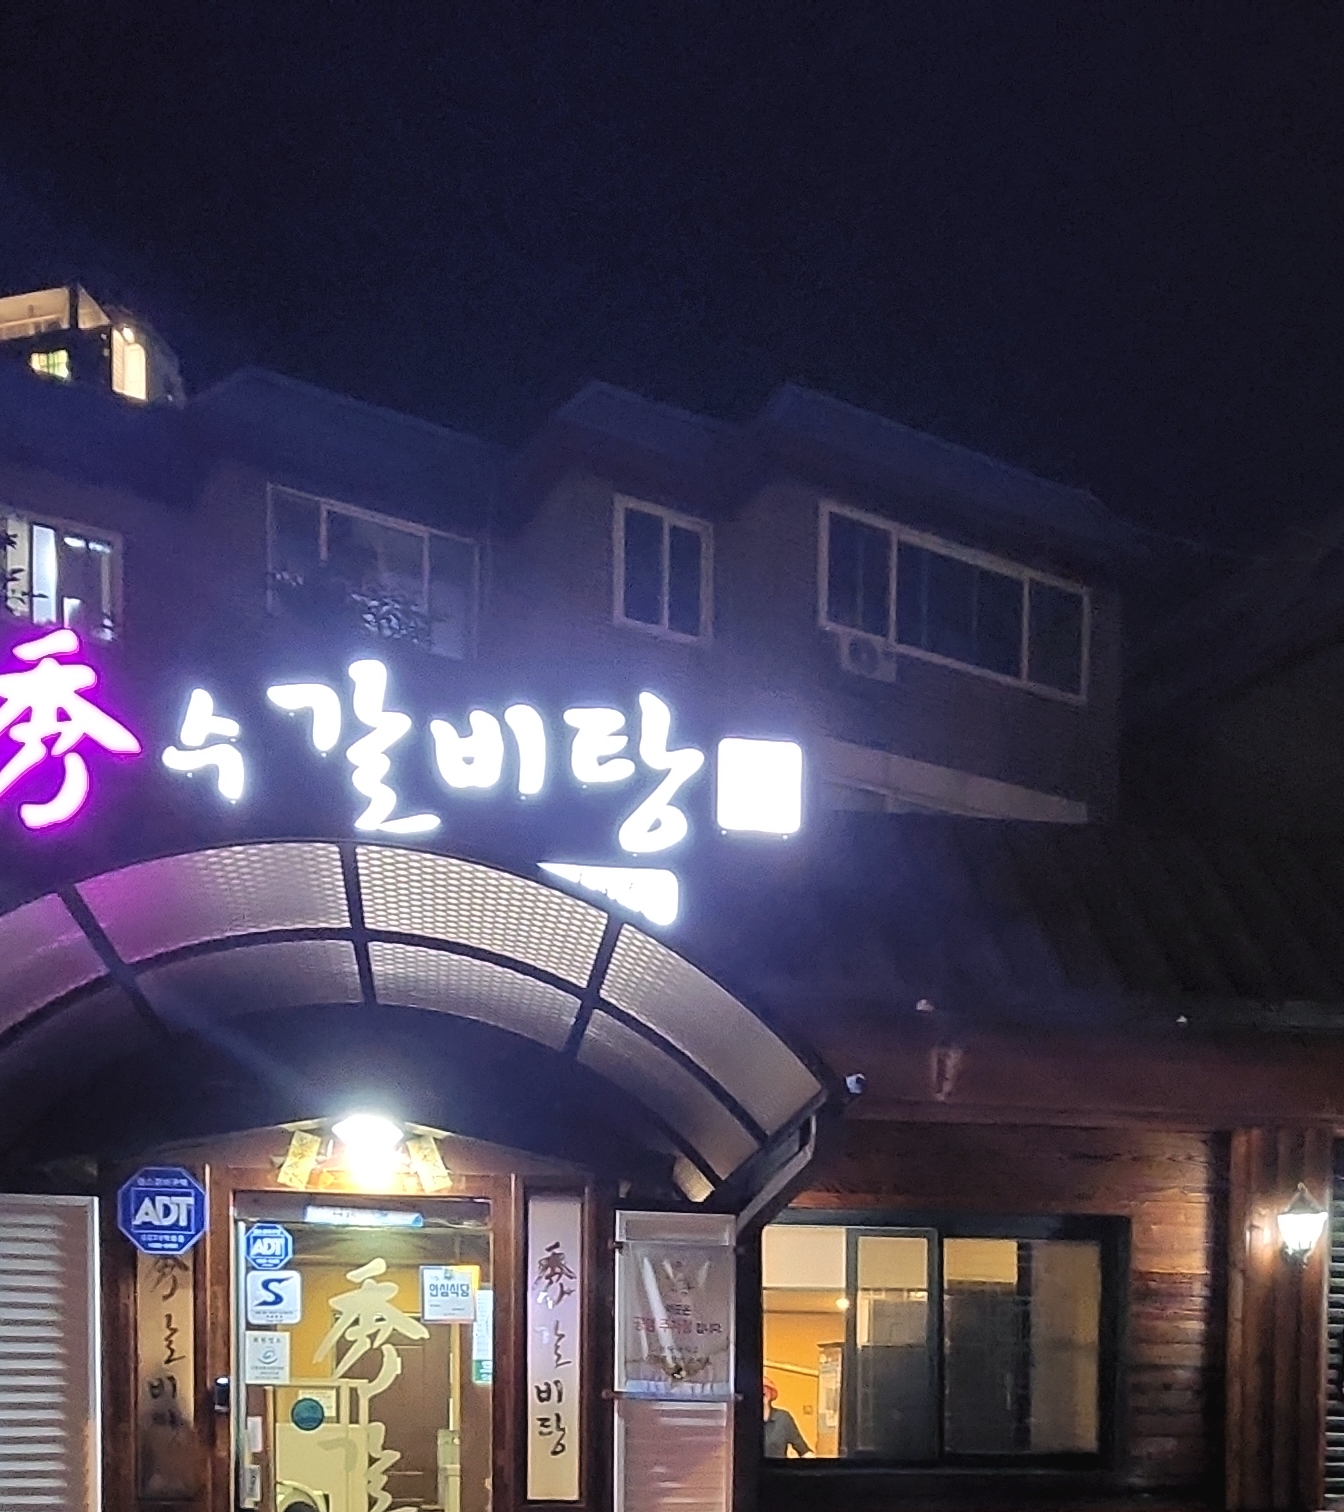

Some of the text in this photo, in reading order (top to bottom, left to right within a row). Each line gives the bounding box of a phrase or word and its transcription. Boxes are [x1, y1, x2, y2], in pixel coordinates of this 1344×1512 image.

[132, 1195, 195, 1227] ADT
[251, 1237, 285, 1258] ADT
[428, 1282, 470, 1298] 안심식당
